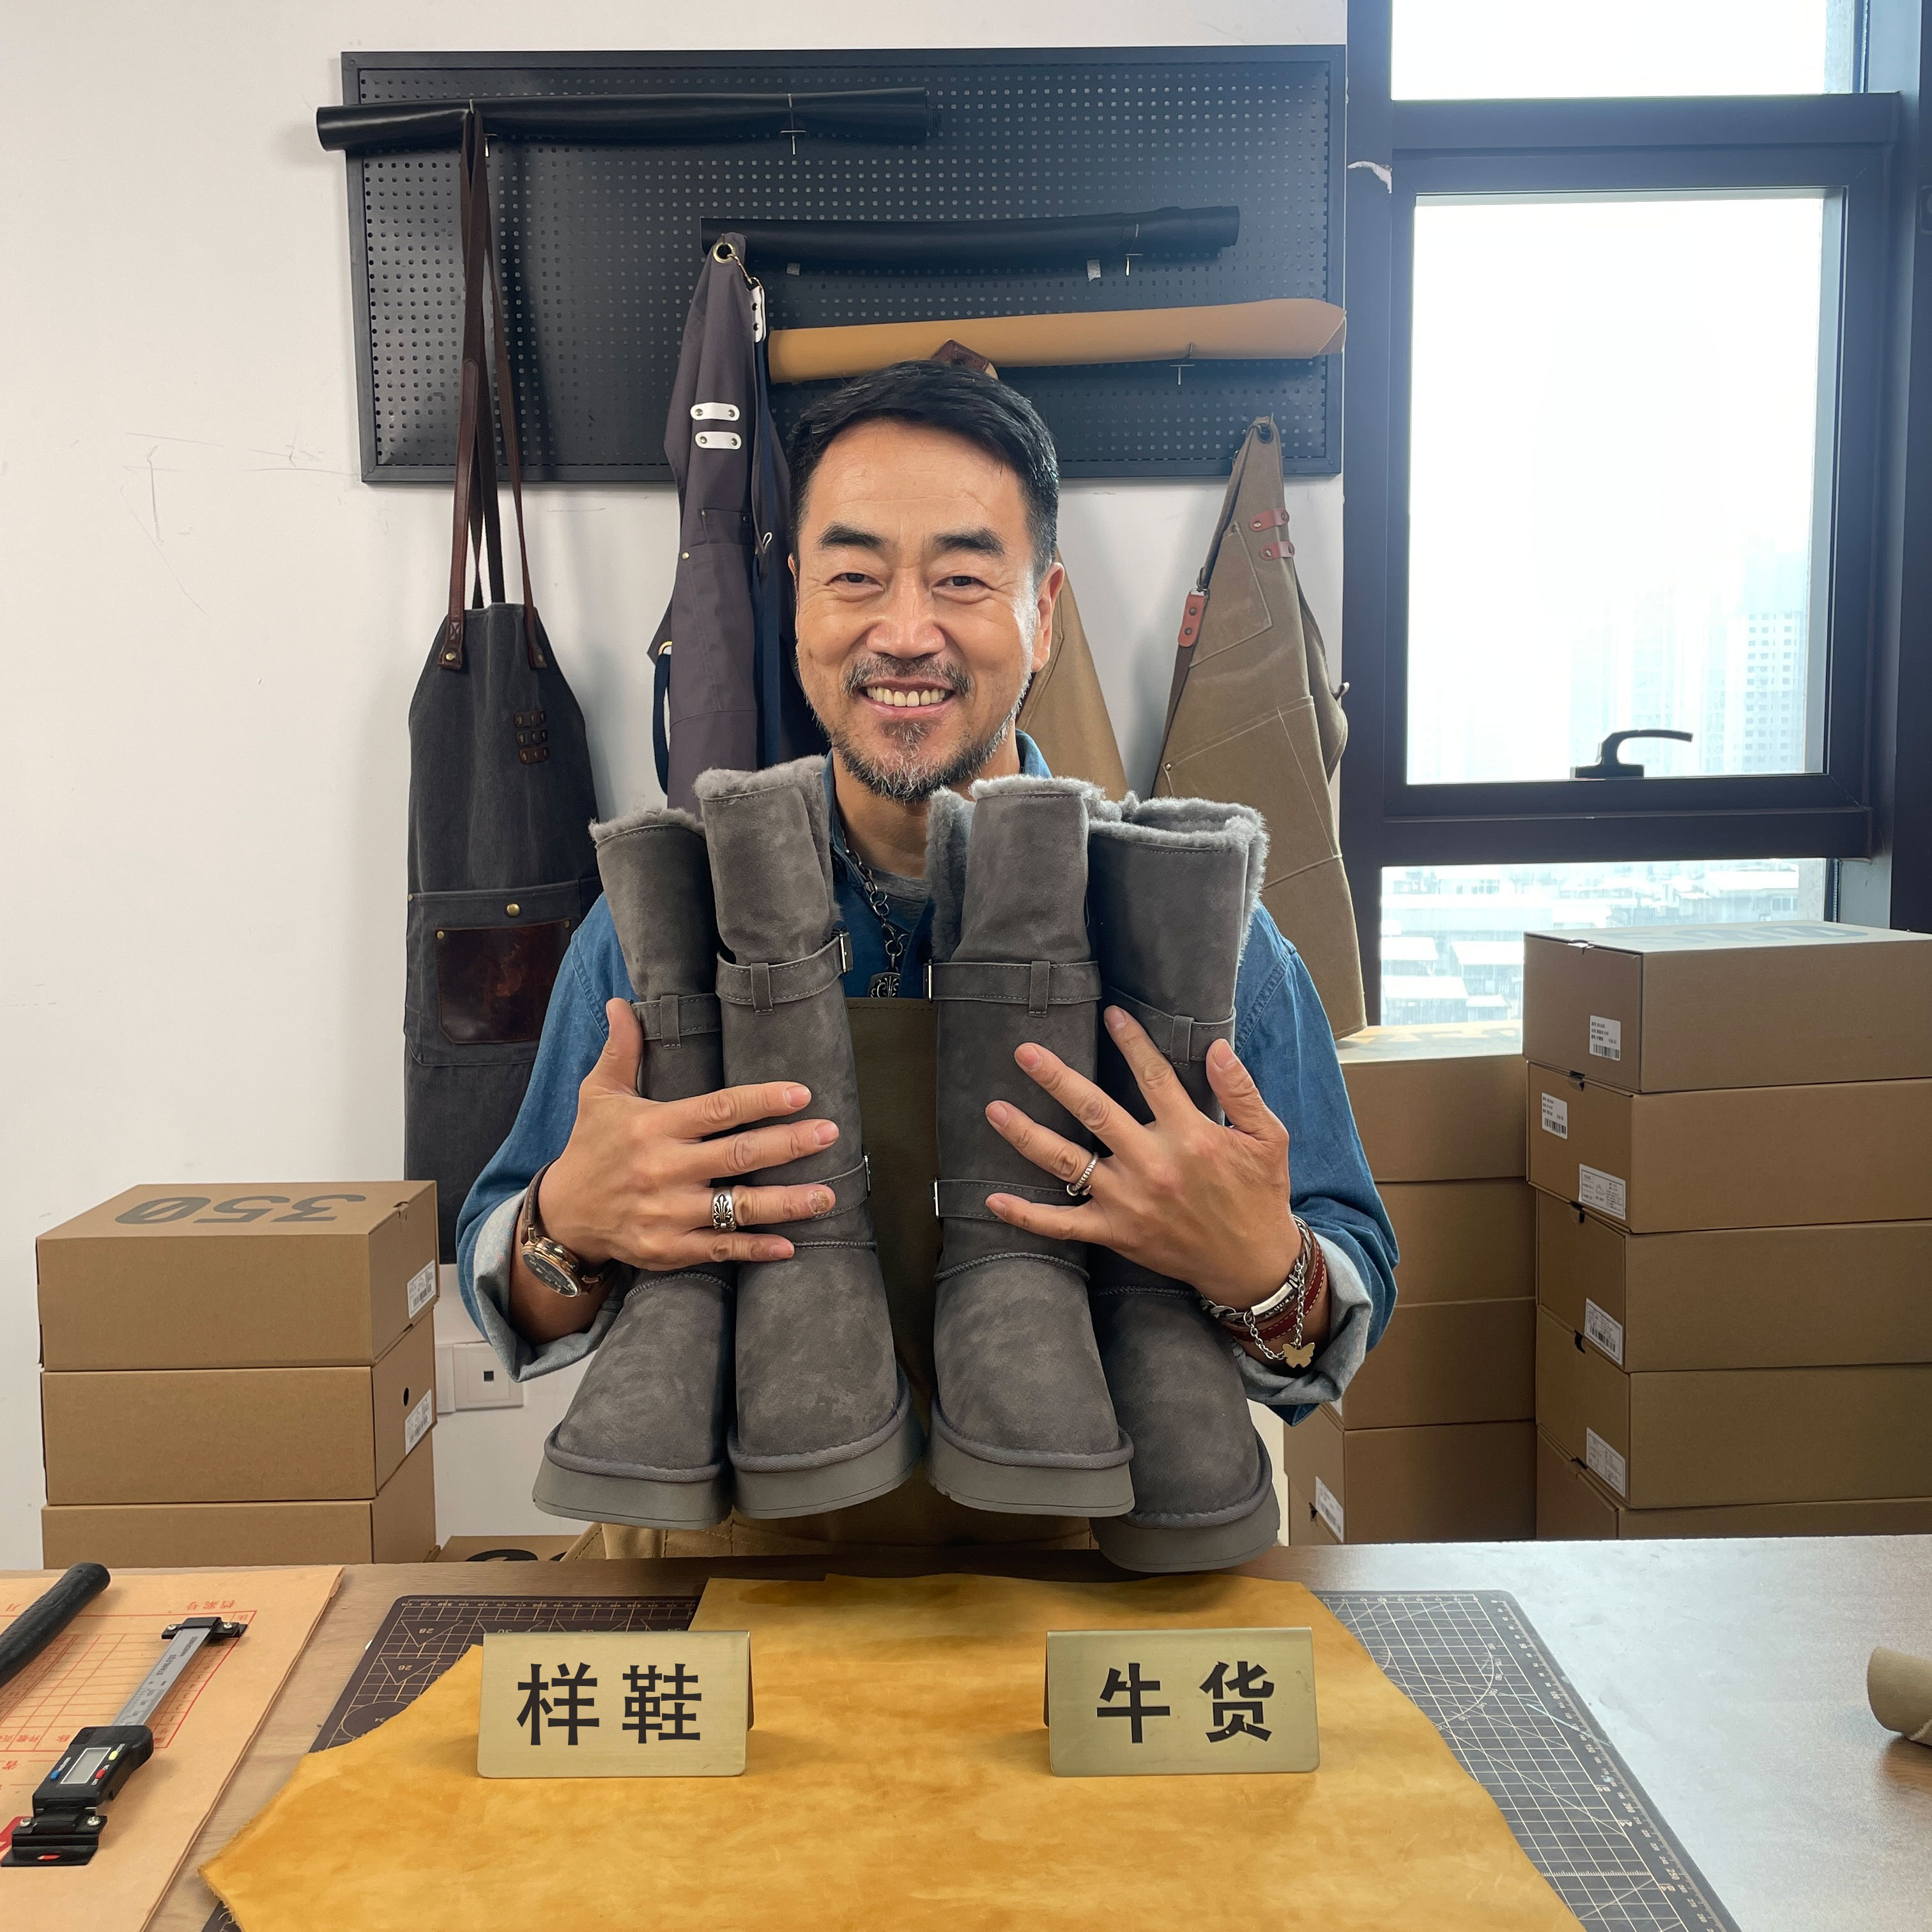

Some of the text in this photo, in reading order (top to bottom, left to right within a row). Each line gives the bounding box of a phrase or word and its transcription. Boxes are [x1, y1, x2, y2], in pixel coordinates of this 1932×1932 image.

[115, 1194, 367, 1224] 350
[517, 1662, 702, 1745] 样鞋
[1097, 1661, 1275, 1744] 牛货
[1623, 1802, 1636, 1813] 200
[1666, 1868, 1680, 1880] 250
